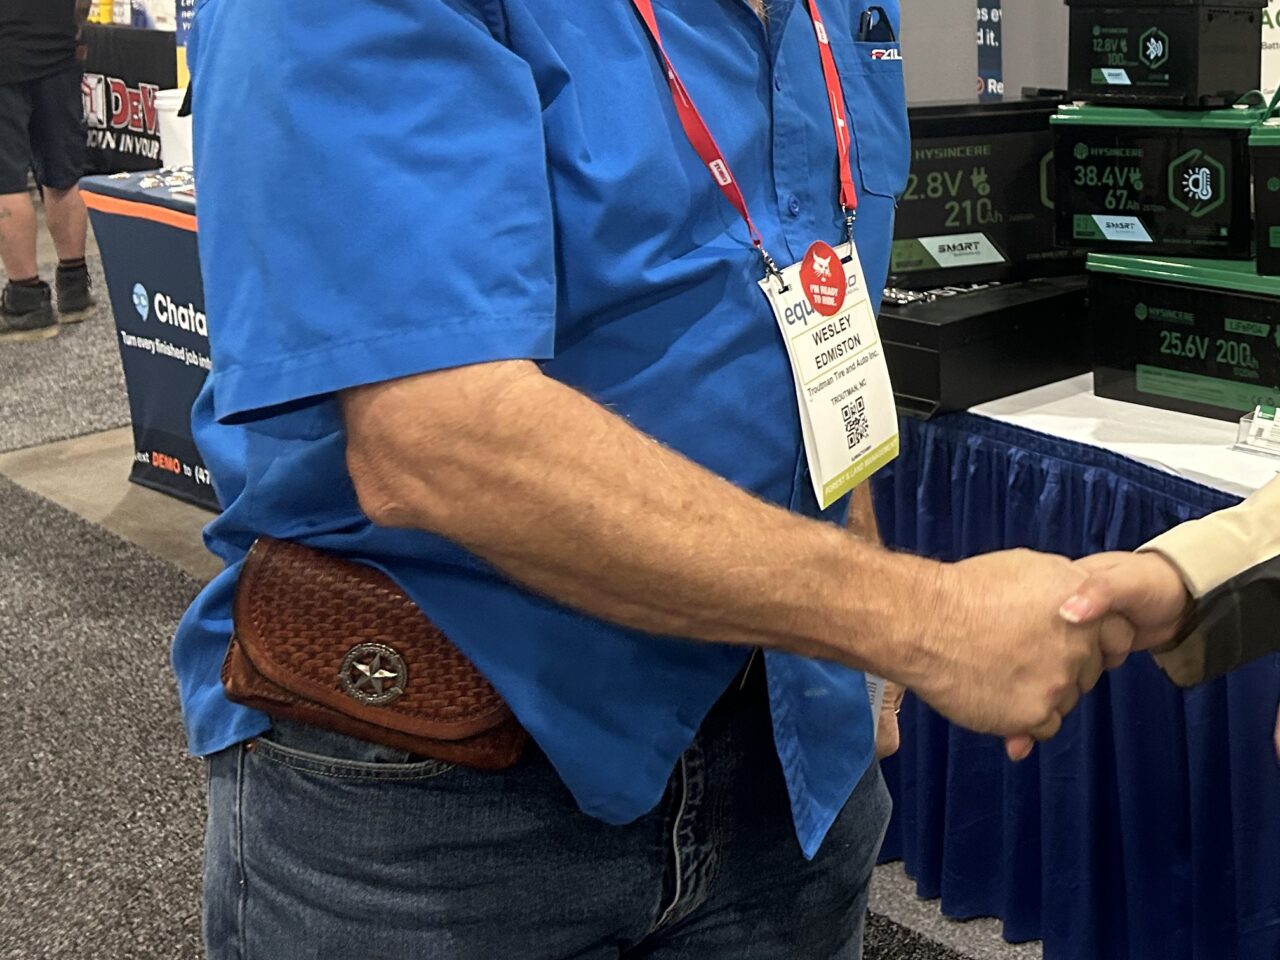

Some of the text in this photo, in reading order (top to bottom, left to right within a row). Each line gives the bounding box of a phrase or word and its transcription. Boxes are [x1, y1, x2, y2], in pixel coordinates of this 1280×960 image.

[914, 144, 993, 160] HYSINCERE
[1074, 165, 1129, 187] 38.4V
[812, 313, 851, 346] WESLEY
[814, 333, 862, 370] EDMISTON
[1160, 330, 1209, 360] 25.6V
[834, 369, 846, 381] Tire
[846, 361, 857, 374] and
[152, 451, 181, 474] DEMO
